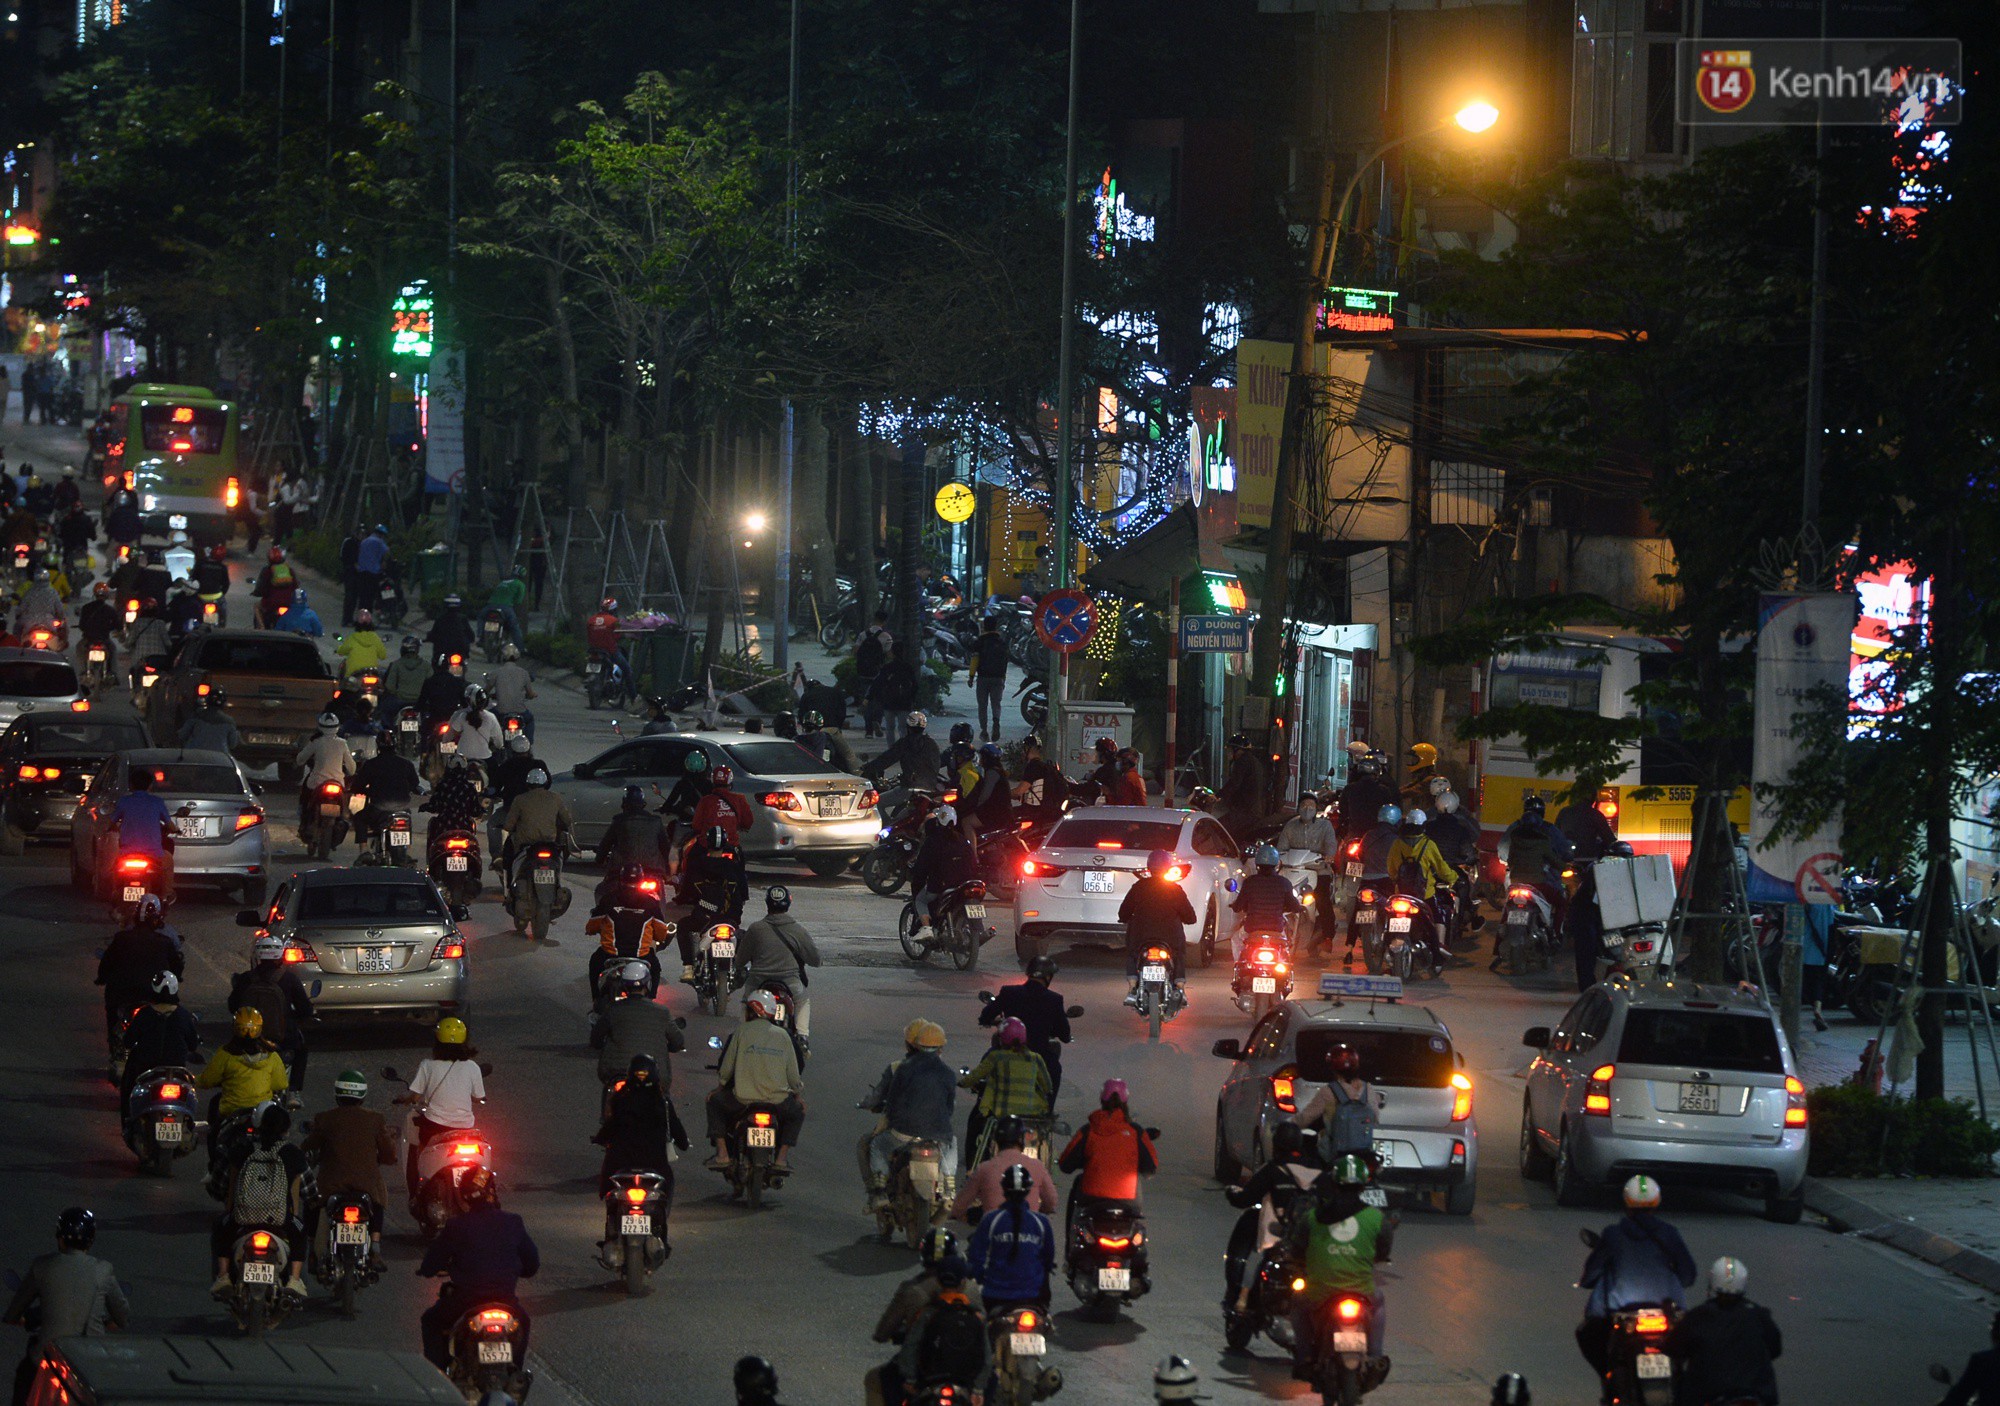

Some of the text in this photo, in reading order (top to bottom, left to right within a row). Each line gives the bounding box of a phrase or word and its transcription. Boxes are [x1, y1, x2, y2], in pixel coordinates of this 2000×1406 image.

[1205, 618, 1241, 629] ĐƯỜNG
[1221, 632, 1242, 648] TUÂN
[183, 819, 199, 828] 30E
[1092, 872, 1107, 882] 30E
[365, 949, 383, 960] 30E
[1690, 1085, 1709, 1097] 29A
[341, 1234, 362, 1242] 8044
